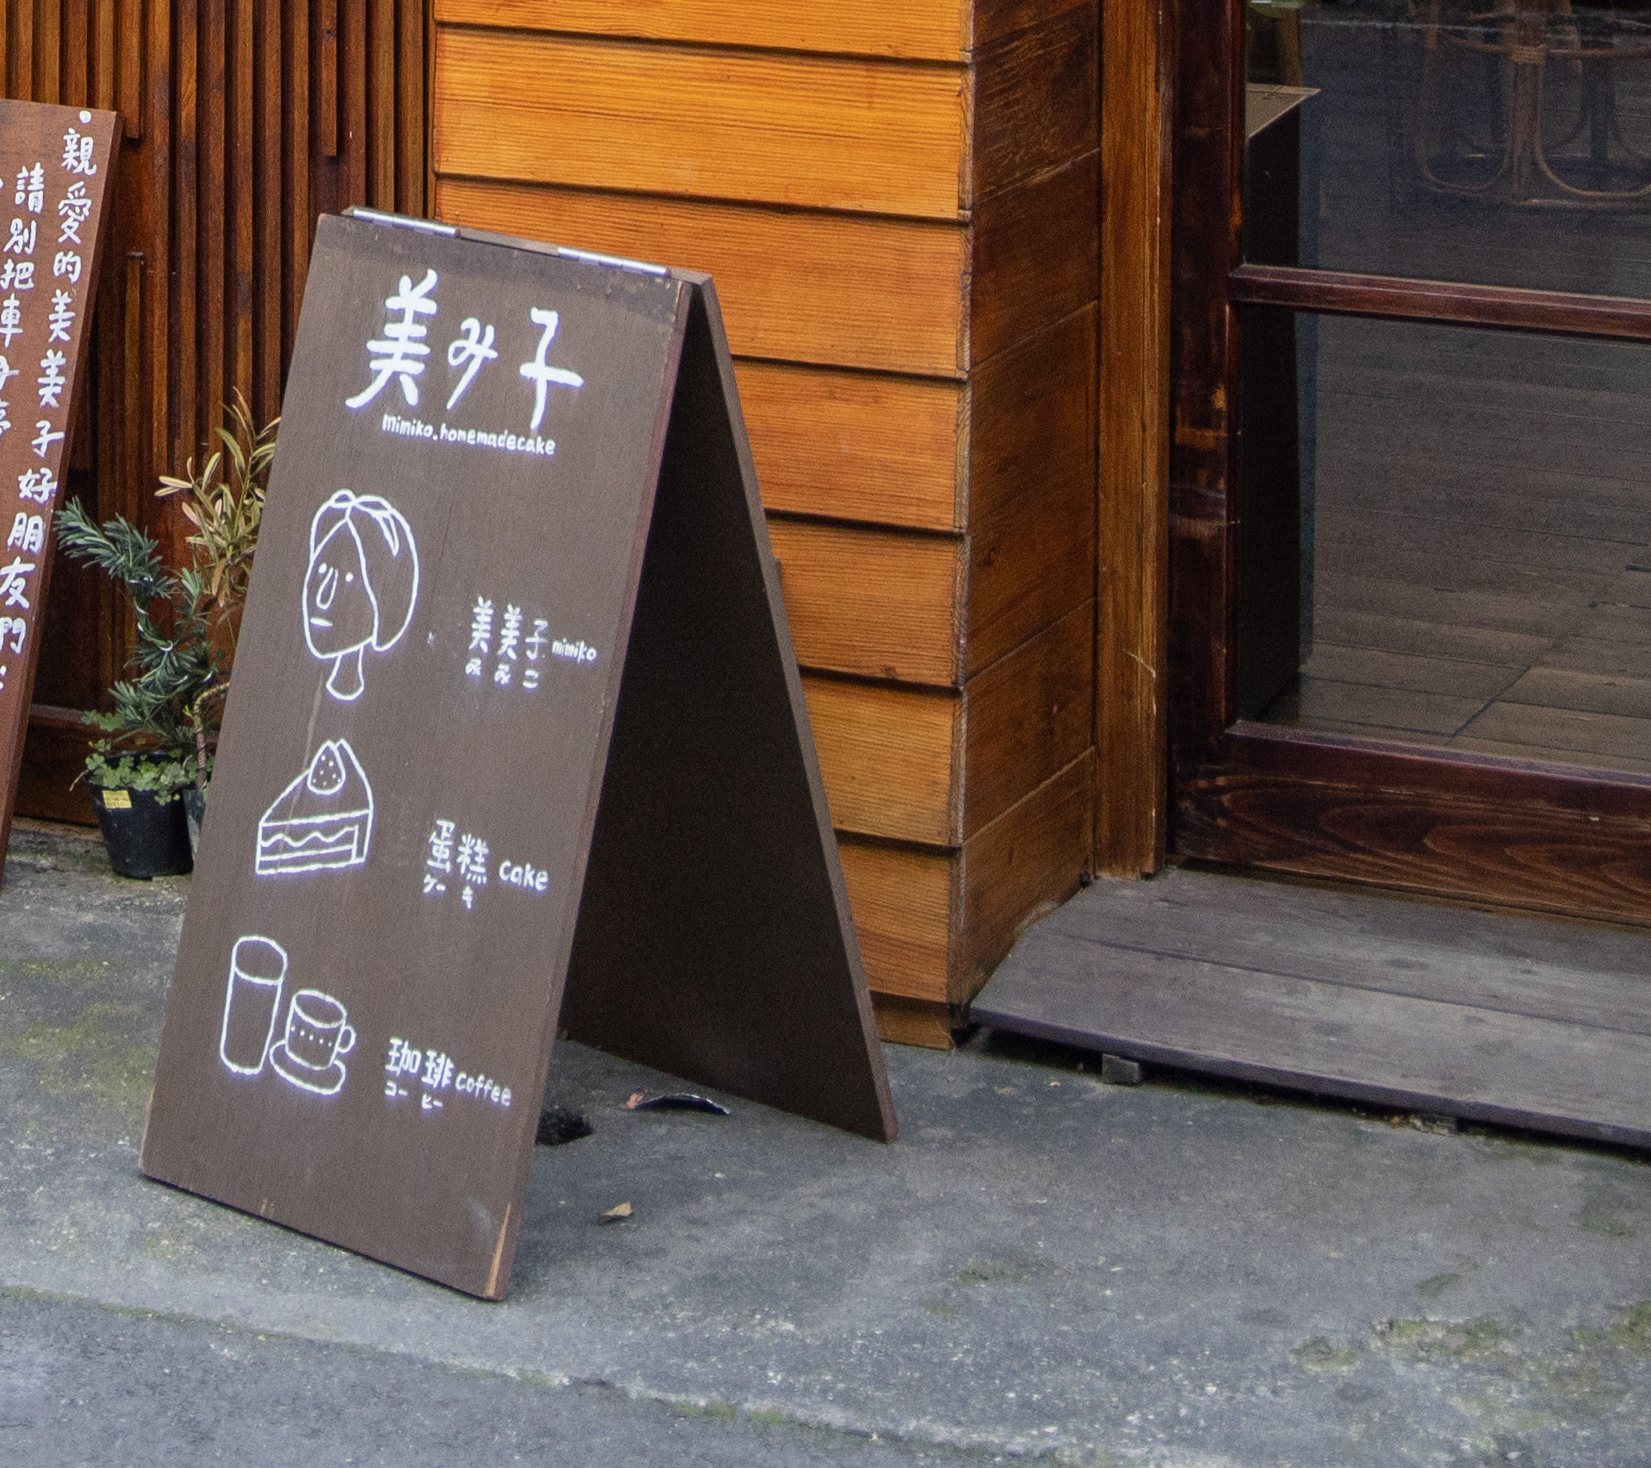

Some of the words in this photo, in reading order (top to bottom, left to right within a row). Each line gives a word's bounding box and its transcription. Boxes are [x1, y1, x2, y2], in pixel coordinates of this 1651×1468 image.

[345, 268, 585, 430] 美み子
[468, 594, 548, 661] 美美子
[552, 638, 597, 663] mimiko
[426, 818, 489, 885] 蛋糕
